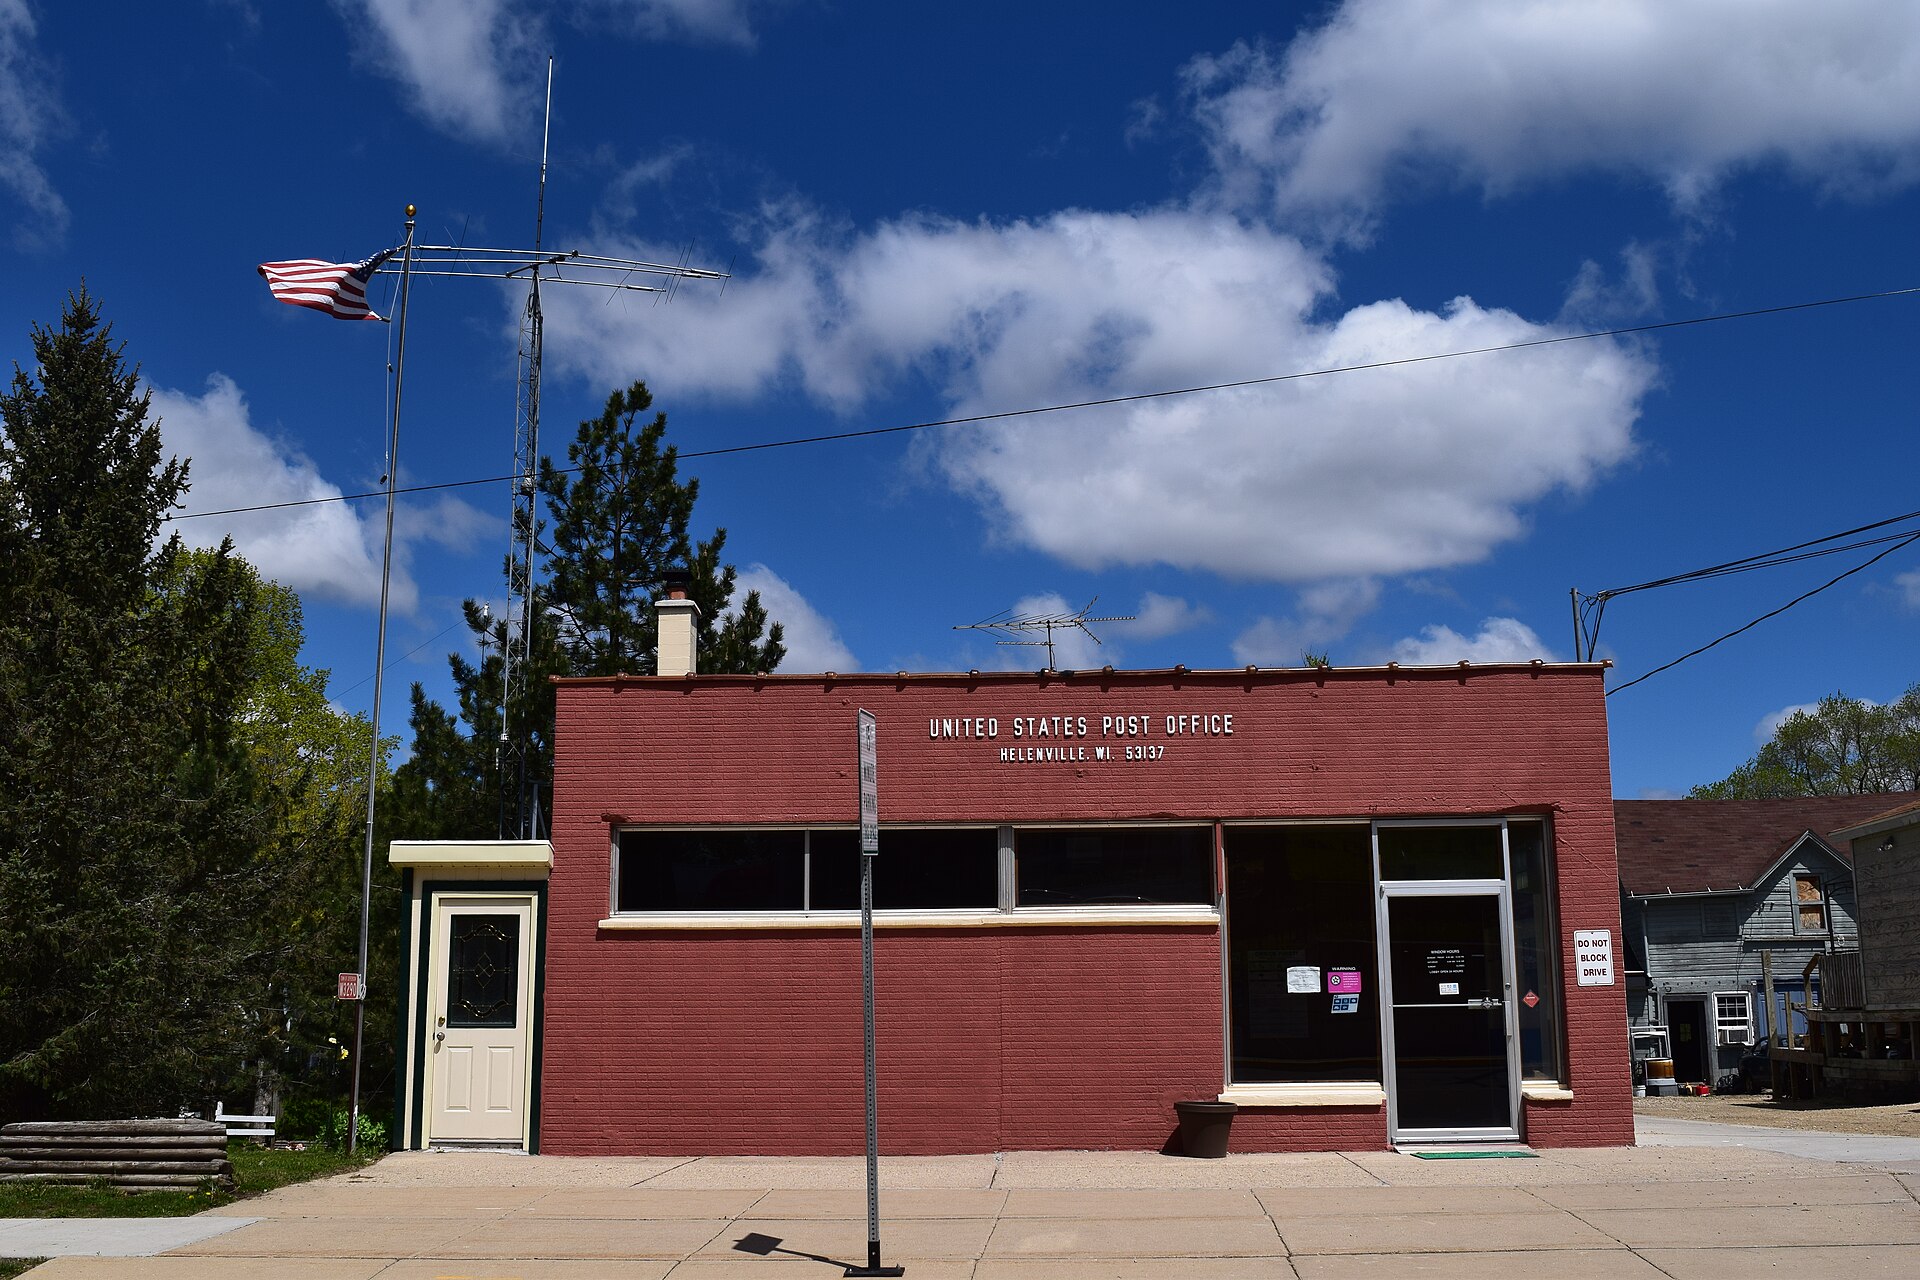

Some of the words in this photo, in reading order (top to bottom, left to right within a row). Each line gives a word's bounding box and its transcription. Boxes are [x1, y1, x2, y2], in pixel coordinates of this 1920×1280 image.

[929, 718, 999, 738] UNITED
[1013, 716, 1087, 737] STATES
[1102, 715, 1150, 736] POST
[1166, 714, 1234, 735] OFFICE
[1095, 746, 1115, 760] WI.
[1125, 746, 1164, 760] 53137
[1592, 940, 1608, 948] NOT
[1580, 954, 1608, 962] BLOCK
